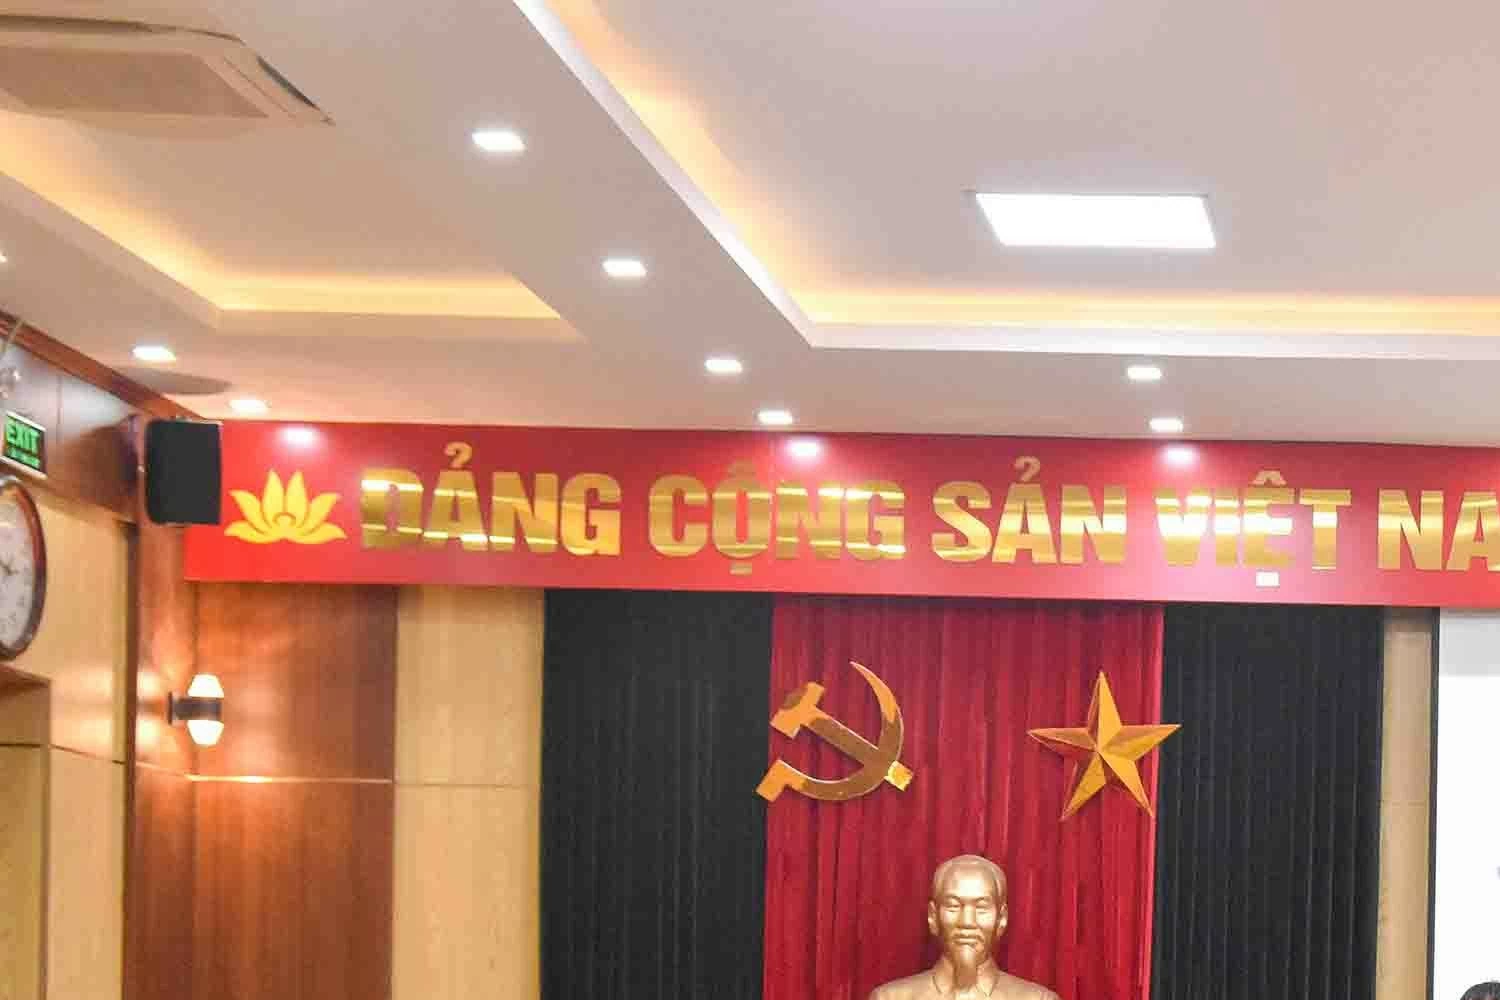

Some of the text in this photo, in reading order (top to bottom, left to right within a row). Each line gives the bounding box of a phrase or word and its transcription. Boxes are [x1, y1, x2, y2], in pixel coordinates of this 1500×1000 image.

[7, 416, 41, 455] EXIT
[361, 441, 622, 556] ĐẢNG
[648, 460, 906, 575] CỘNG
[931, 456, 1127, 564] SẢN
[1155, 470, 1352, 587] VIỆT
